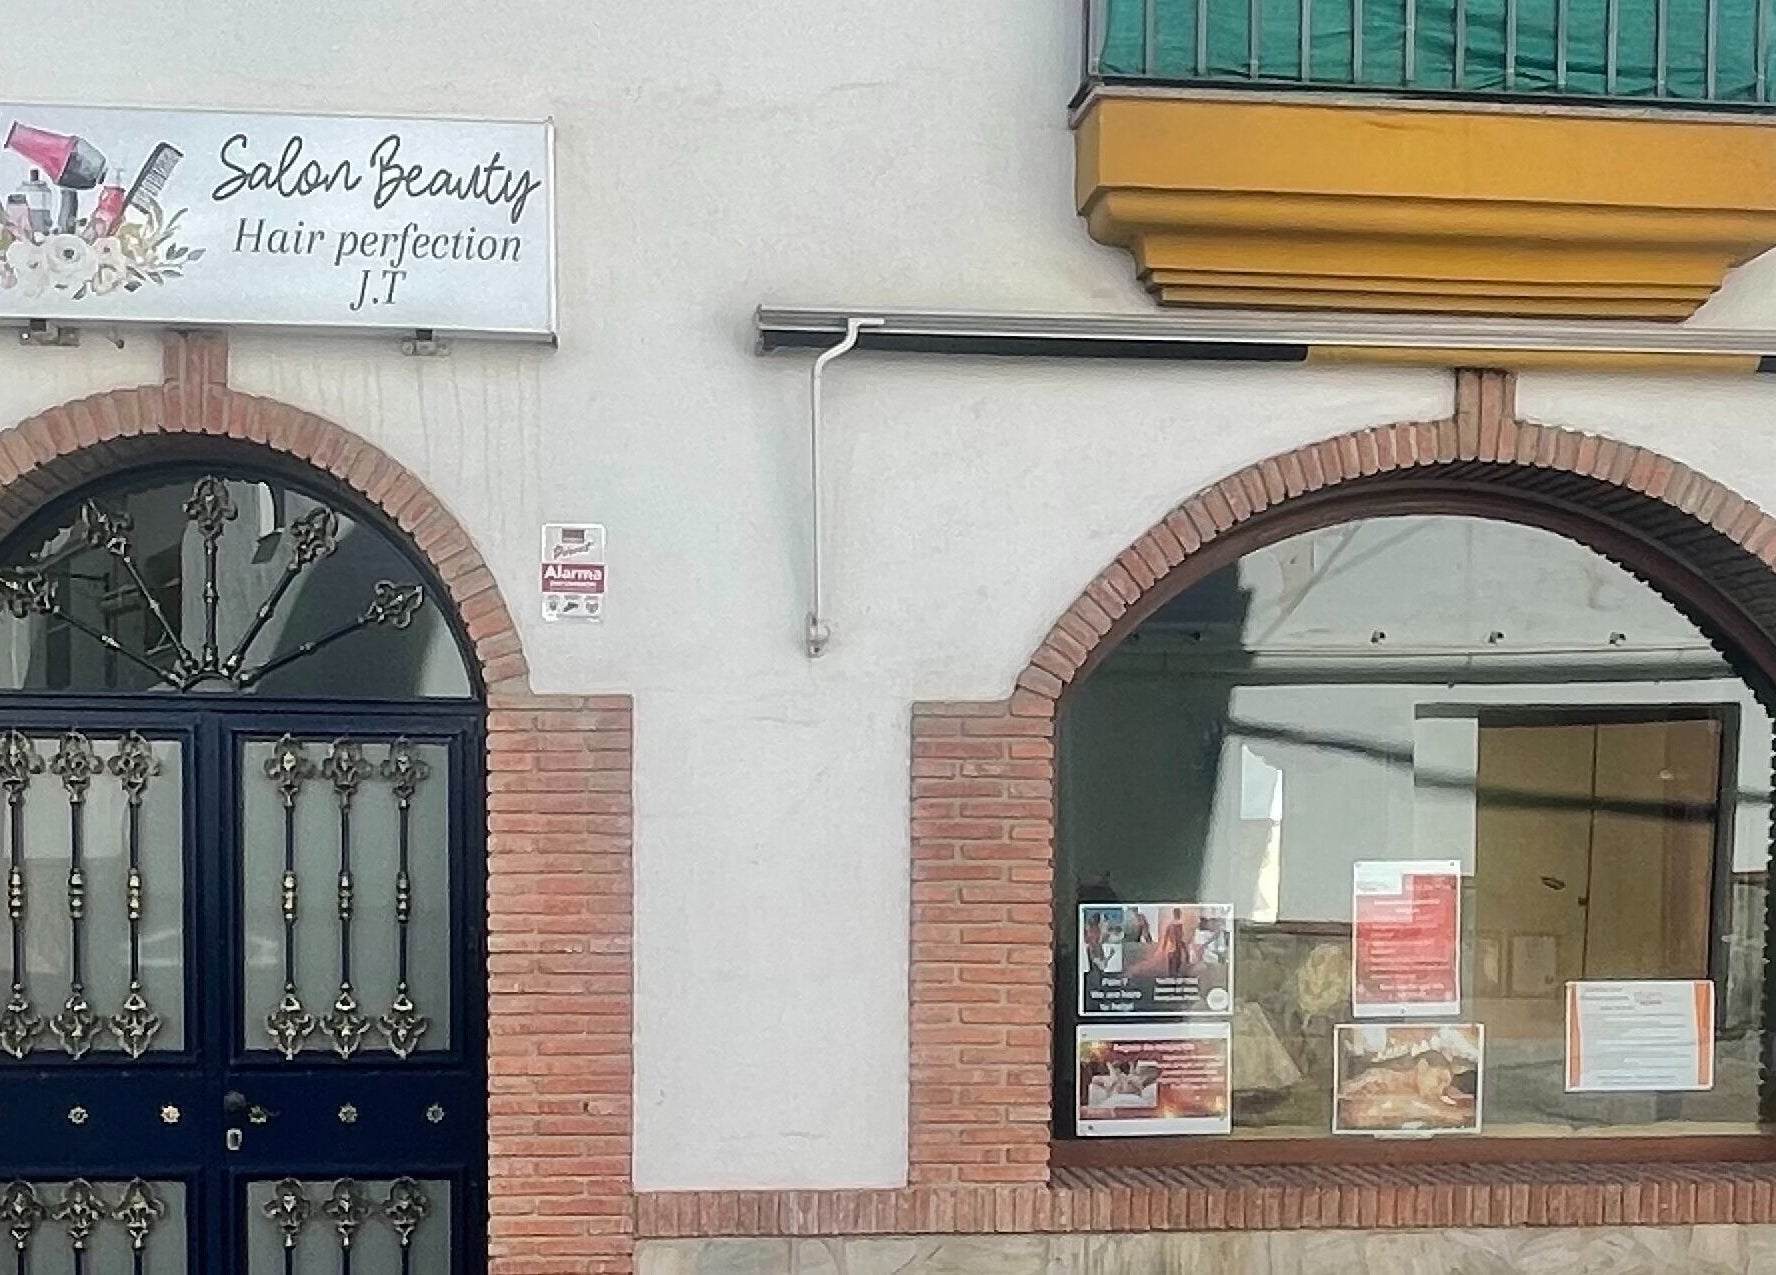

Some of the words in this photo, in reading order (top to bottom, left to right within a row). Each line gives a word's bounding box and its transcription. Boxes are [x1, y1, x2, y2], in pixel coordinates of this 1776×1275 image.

[212, 134, 362, 201] Salon
[369, 134, 542, 222] Beauty
[234, 218, 325, 254] Hair
[335, 222, 521, 267] perfection
[350, 271, 407, 311] J.T
[544, 564, 603, 581] Alarma
